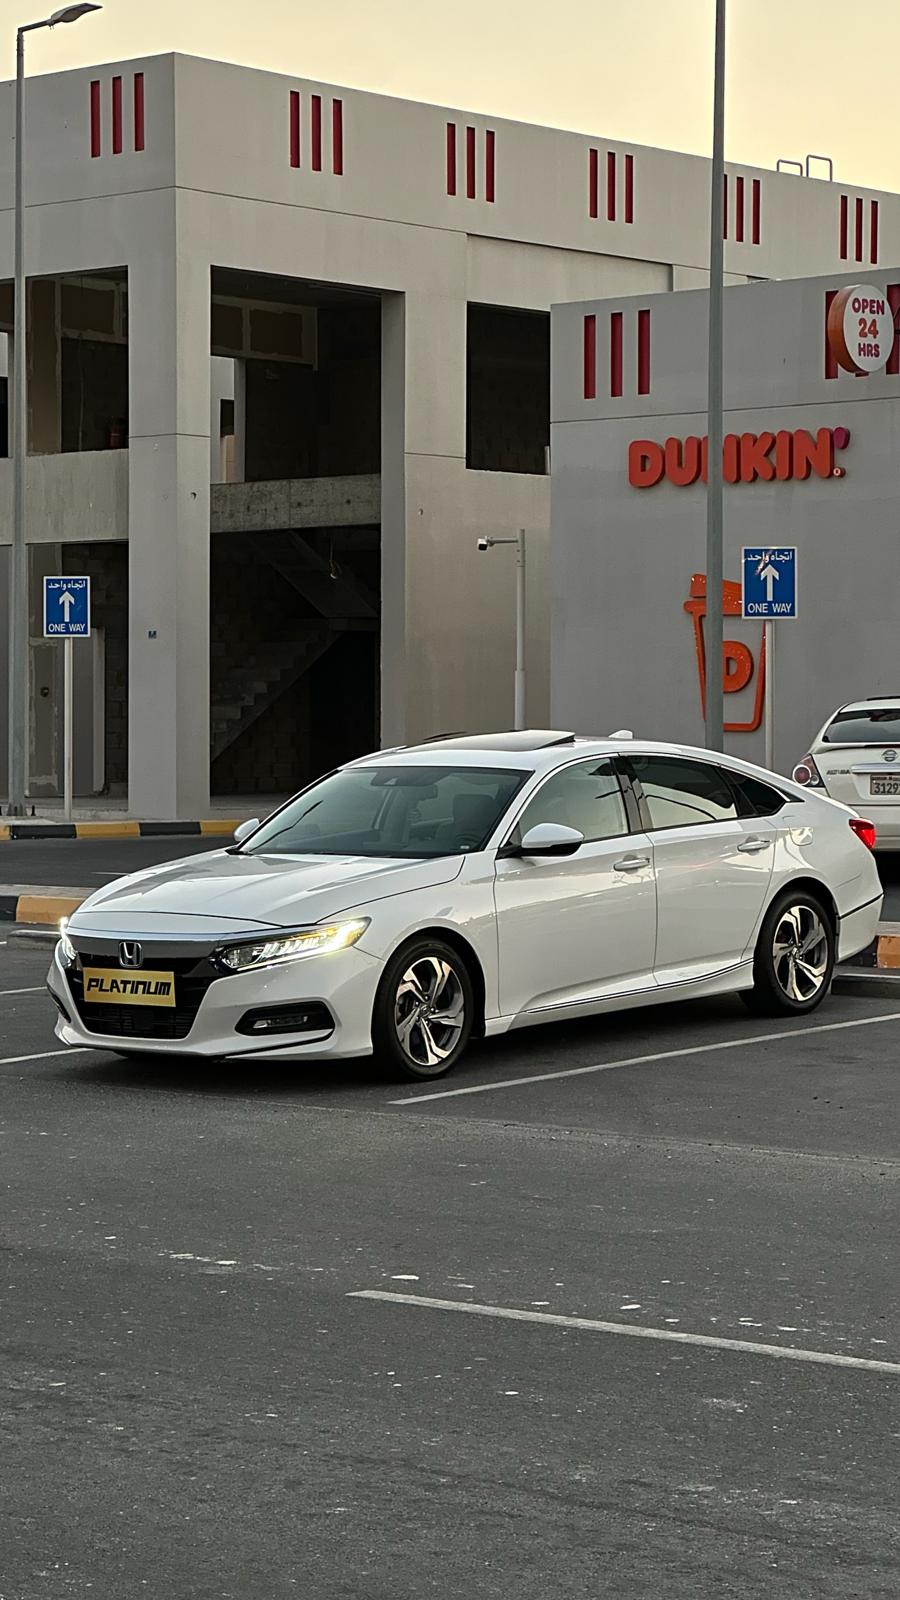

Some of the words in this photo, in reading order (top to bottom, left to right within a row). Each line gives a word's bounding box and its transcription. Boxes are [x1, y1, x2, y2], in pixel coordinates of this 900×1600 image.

[852, 297, 885, 315] OPEN
[858, 318, 878, 339] 24
[858, 342, 880, 358] HRS
[747, 551, 769, 563] واحد
[770, 551, 792, 563] اتجاه
[48, 580, 67, 590] واحد
[67, 580, 86, 590] اتجاه
[747, 603, 768, 613] ONE
[772, 603, 792, 613] WAY
[48, 623, 66, 632] ONE
[69, 623, 85, 632] WAY
[874, 782, 900, 794] 3129
[87, 977, 171, 996] PLATINUM
